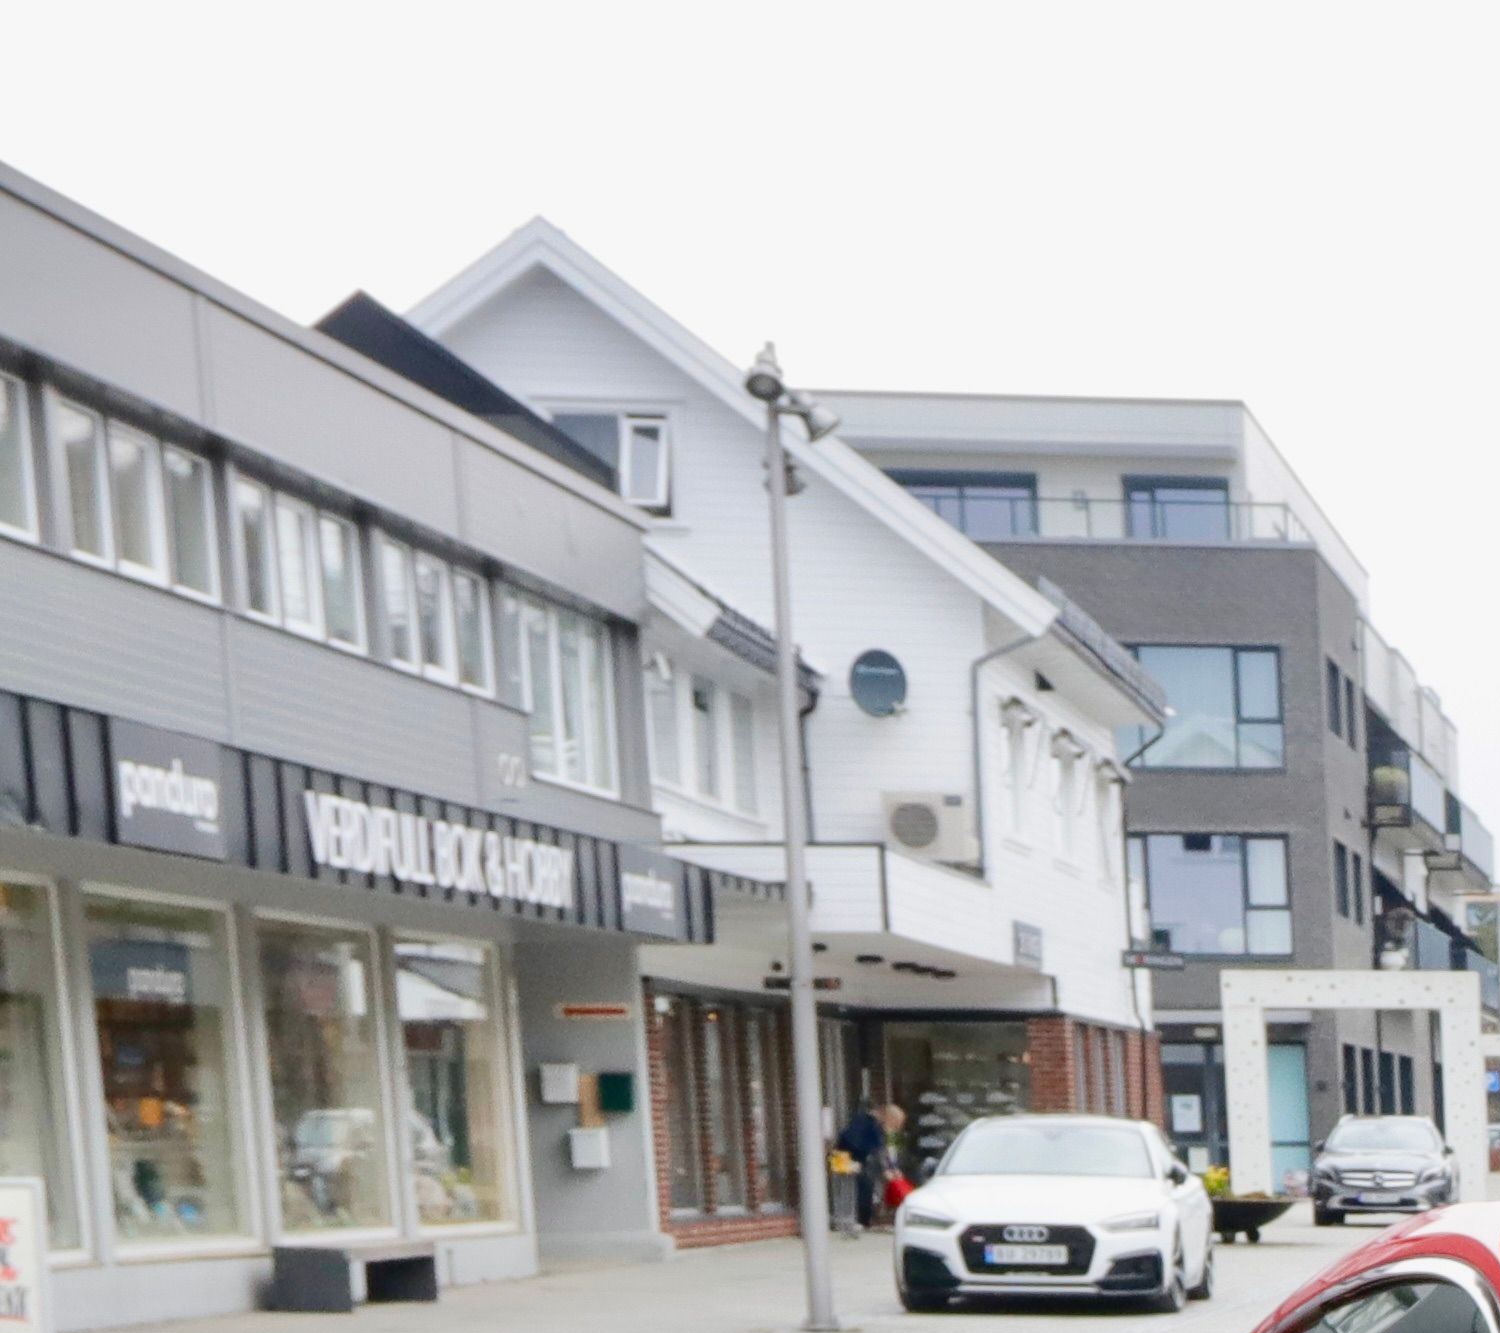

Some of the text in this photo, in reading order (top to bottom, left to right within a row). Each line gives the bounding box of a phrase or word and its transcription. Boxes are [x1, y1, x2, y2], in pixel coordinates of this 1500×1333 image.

[118, 758, 218, 820] panduro
[304, 789, 436, 886] VERDIFULL
[433, 819, 487, 894] BOK
[484, 830, 506, 898] &
